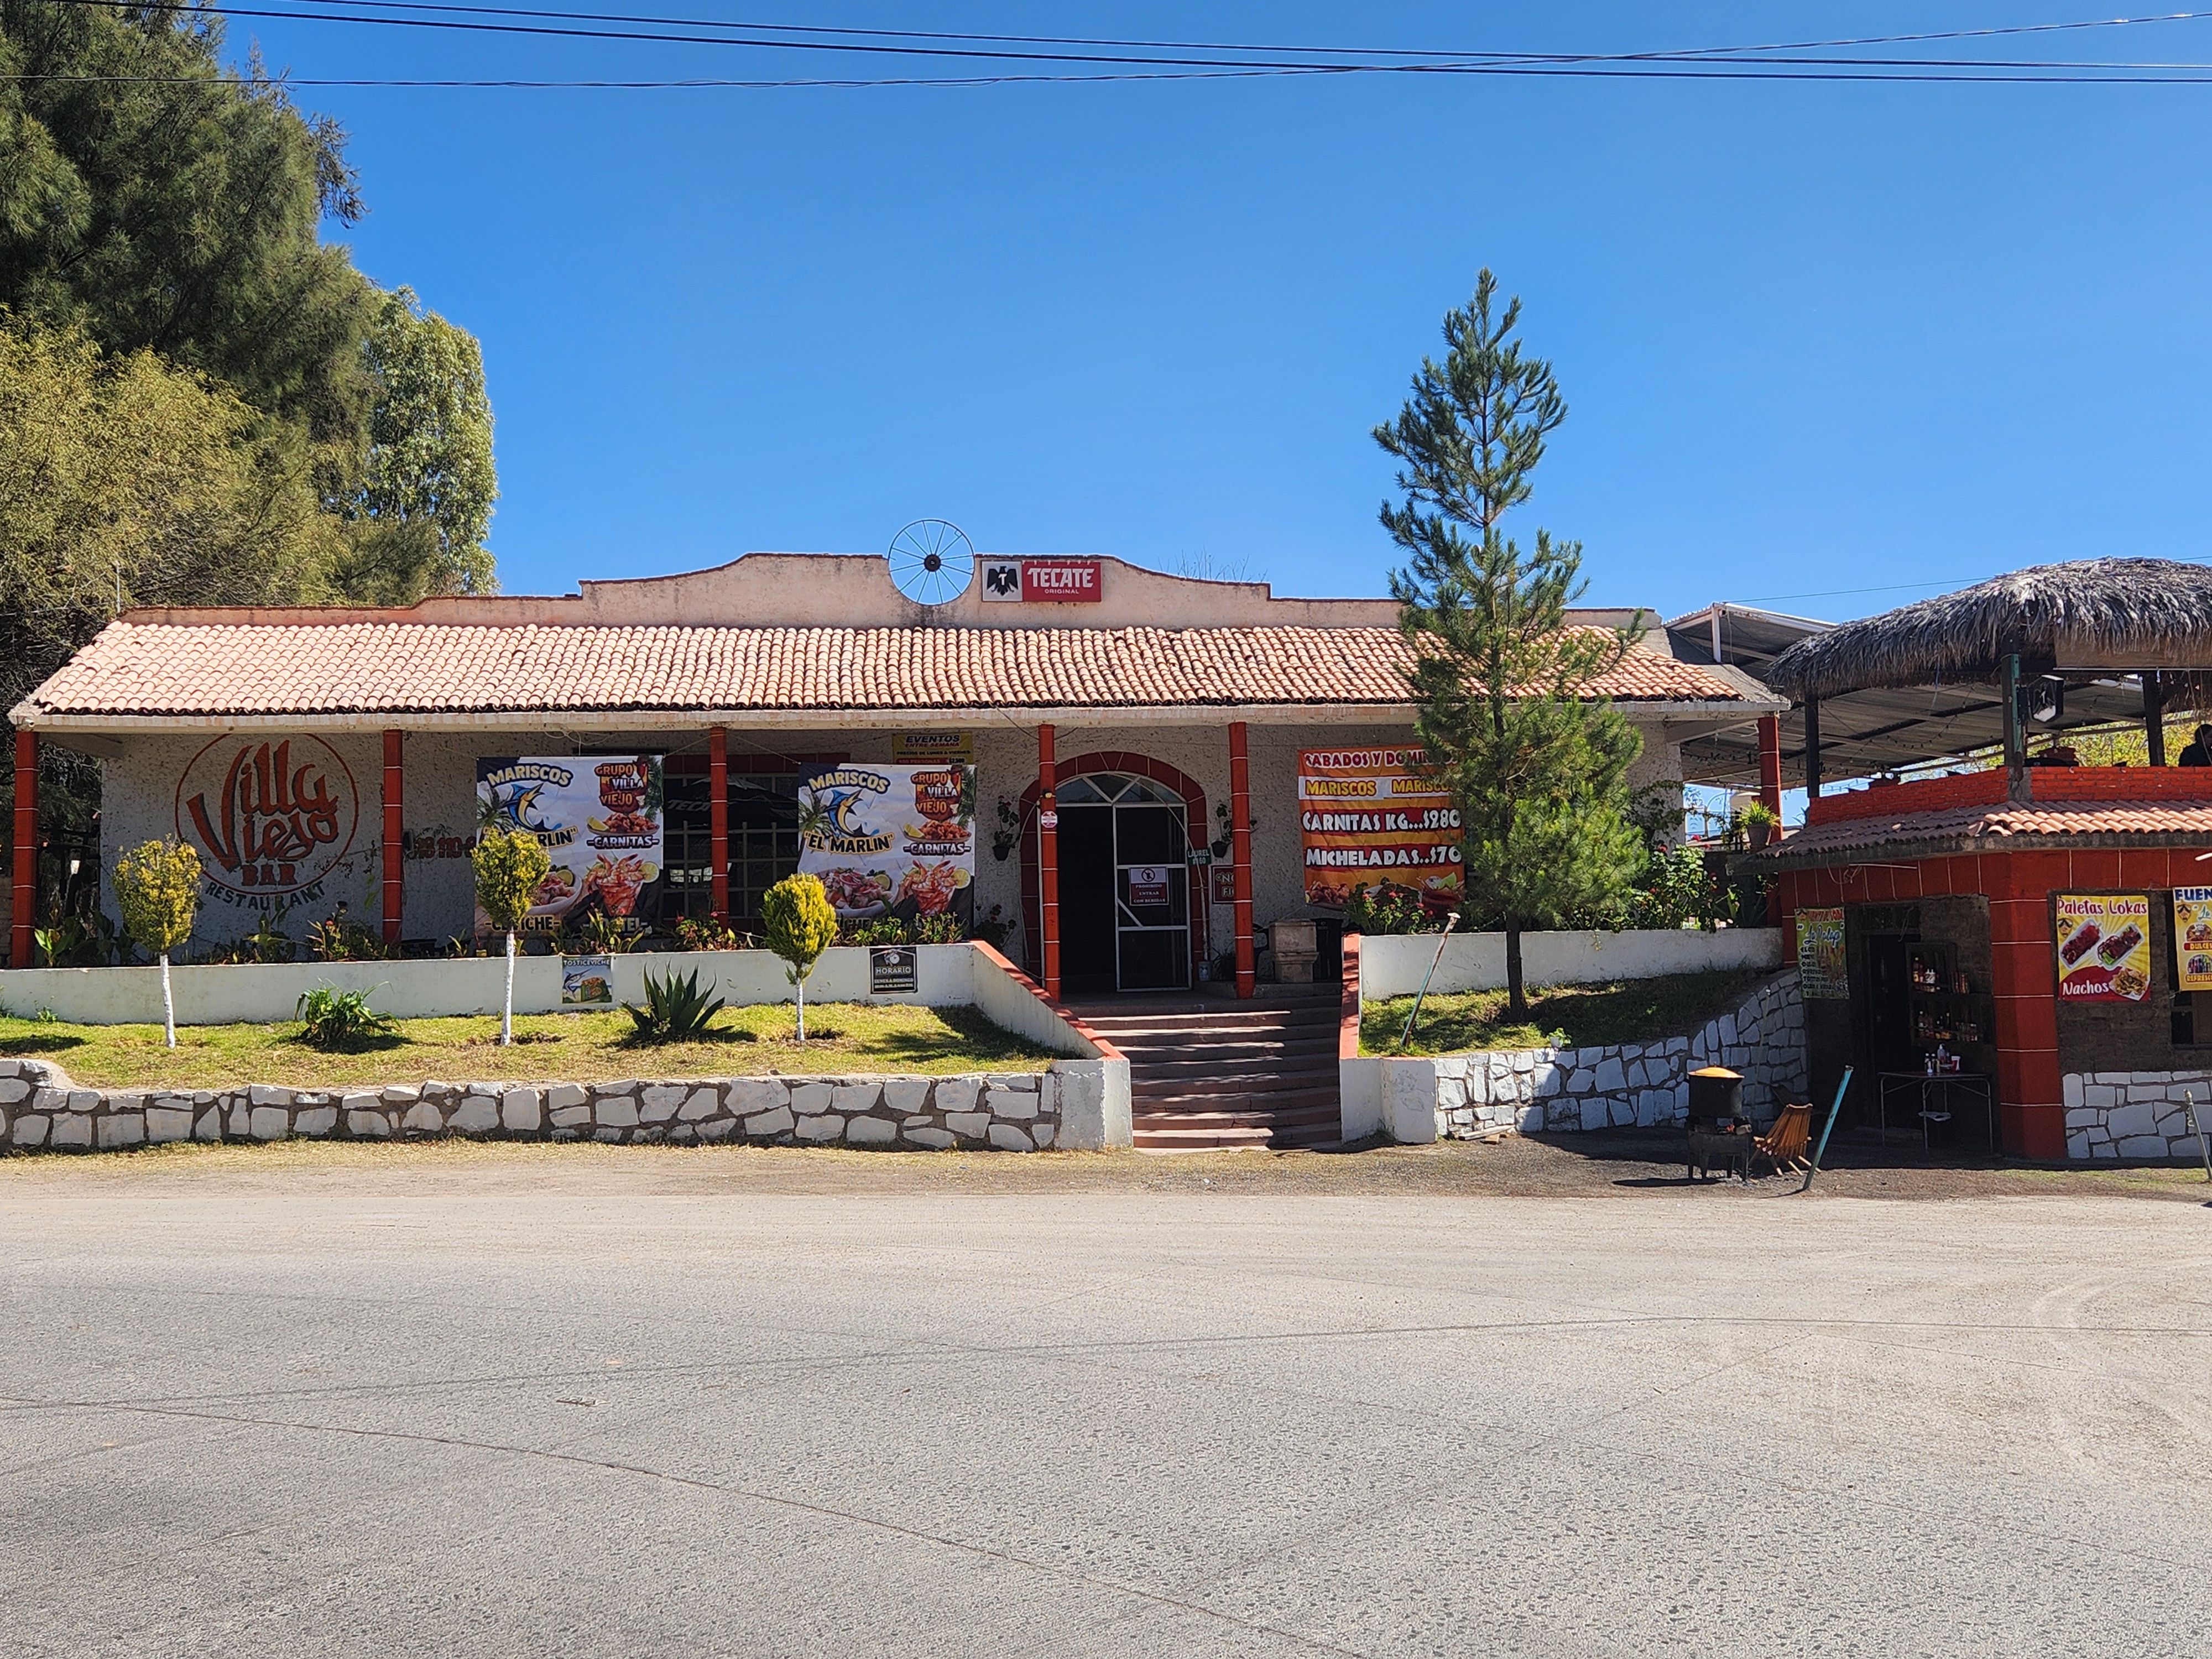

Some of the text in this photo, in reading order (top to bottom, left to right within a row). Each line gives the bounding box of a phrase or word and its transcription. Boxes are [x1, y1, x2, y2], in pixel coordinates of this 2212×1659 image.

[1027, 568, 1095, 588] TECATE
[906, 735, 960, 743] EVENTOS
[1305, 752, 1368, 766] SABADOS
[1373, 752, 1381, 765] Y
[487, 765, 572, 786] MARISCOS
[596, 764, 633, 775] GRUPO
[612, 779, 644, 789] VILLA
[808, 771, 889, 792] MARISCOS
[912, 773, 947, 784] GRUPO
[927, 787, 958, 797] VILLA
[1306, 781, 1376, 795] MARISCOS
[601, 793, 633, 805] VIEJO
[667, 799, 711, 812] TECA
[916, 800, 947, 813] VIEJO
[1303, 811, 1381, 831] CARNITAS
[1188, 849, 1209, 858] LAUREL
[242, 863, 298, 886] BAR
[205, 881, 326, 911] RESTAURANT
[2057, 899, 2147, 915] Paletas Lokas
[2063, 979, 2109, 996] Nachos
